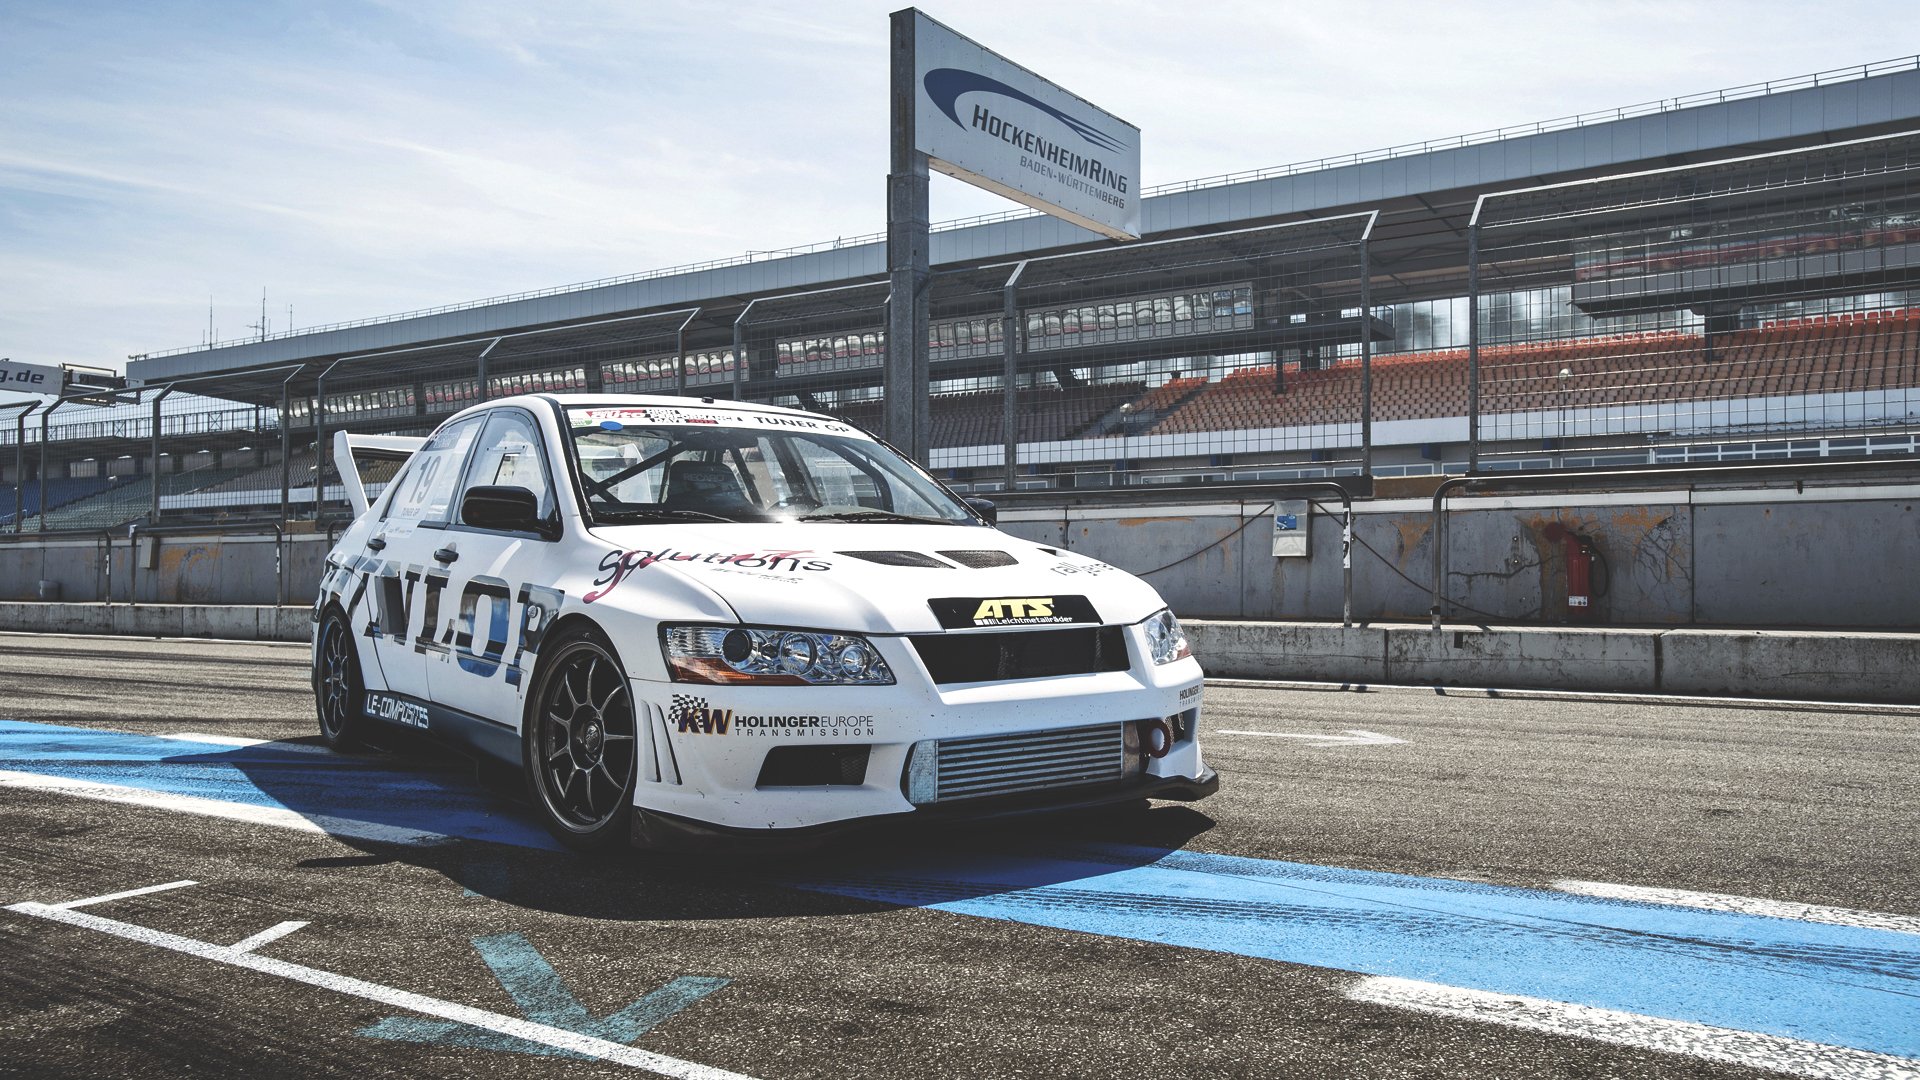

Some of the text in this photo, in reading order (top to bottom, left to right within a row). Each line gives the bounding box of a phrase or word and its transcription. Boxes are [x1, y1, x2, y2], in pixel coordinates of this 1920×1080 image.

[972, 104, 1128, 194] HOCKENHEIMRING
[1019, 155, 1126, 209] BADEN-WÜRTTEMBERG
[753, 416, 818, 429] TUNER
[409, 455, 442, 504] 19
[973, 597, 1054, 620] ATS
[996, 615, 1073, 625] Leichtmetallräder
[366, 693, 429, 729] LE-COMPOSITES
[677, 708, 734, 736] KW
[735, 728, 874, 736] TRANSMISSION
